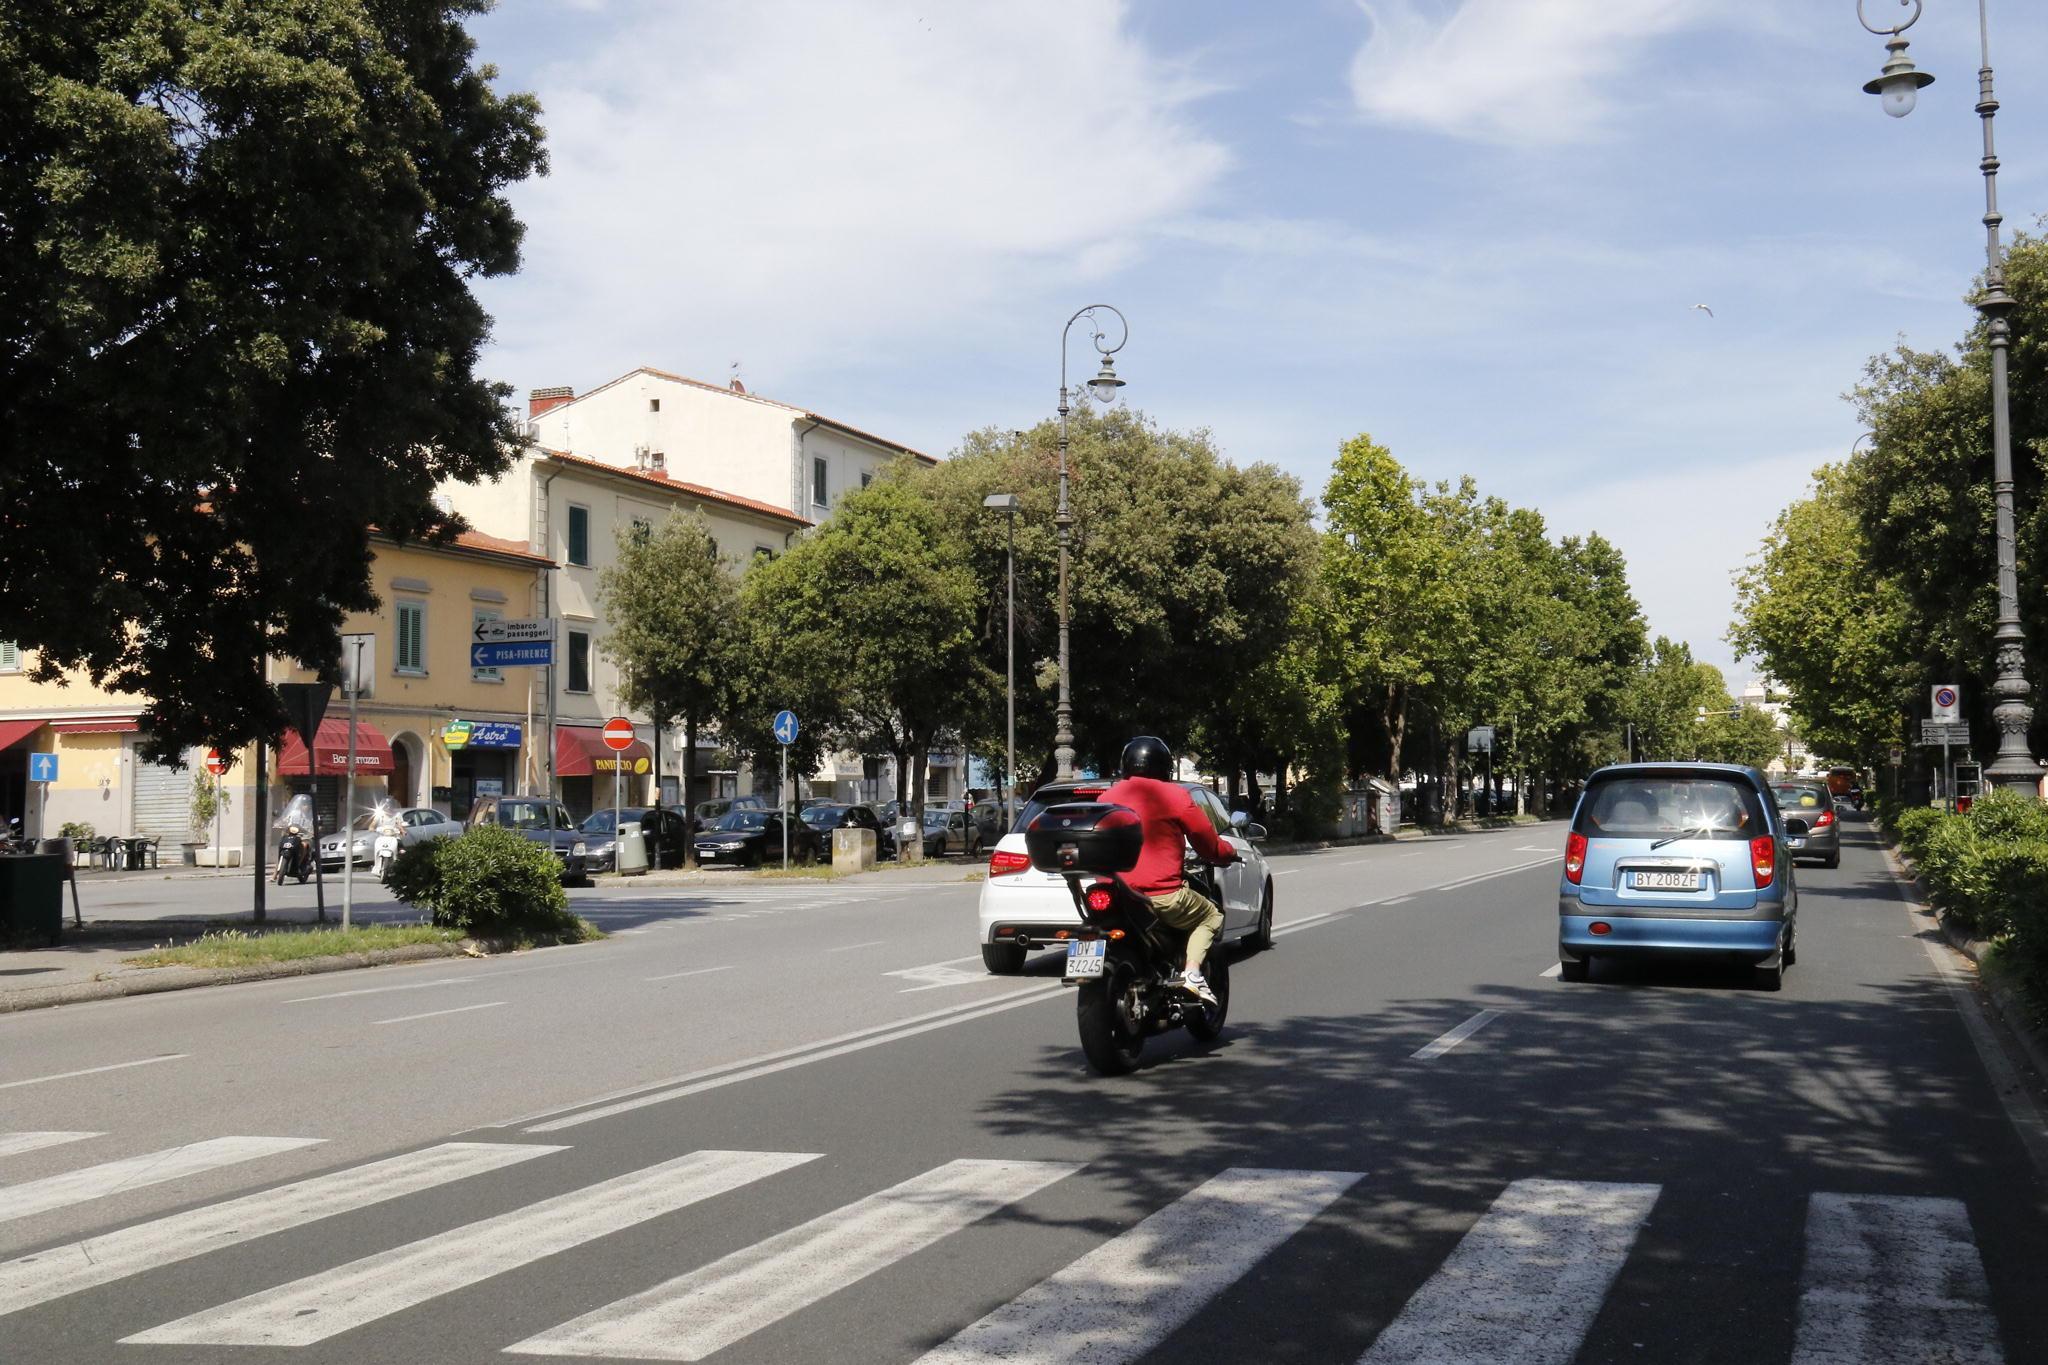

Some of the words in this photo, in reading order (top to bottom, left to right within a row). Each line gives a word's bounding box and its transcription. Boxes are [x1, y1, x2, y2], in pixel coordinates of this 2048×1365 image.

[507, 629, 548, 638] passeggeri
[496, 648, 548, 660] PISA-FIRENZE
[471, 728, 506, 741] Astro
[595, 760, 632, 770] PANIFCIO
[1636, 873, 1651, 886] BY
[1656, 873, 1697, 887] 208ZF
[1077, 940, 1091, 956] DV
[1068, 959, 1101, 974] 34245
